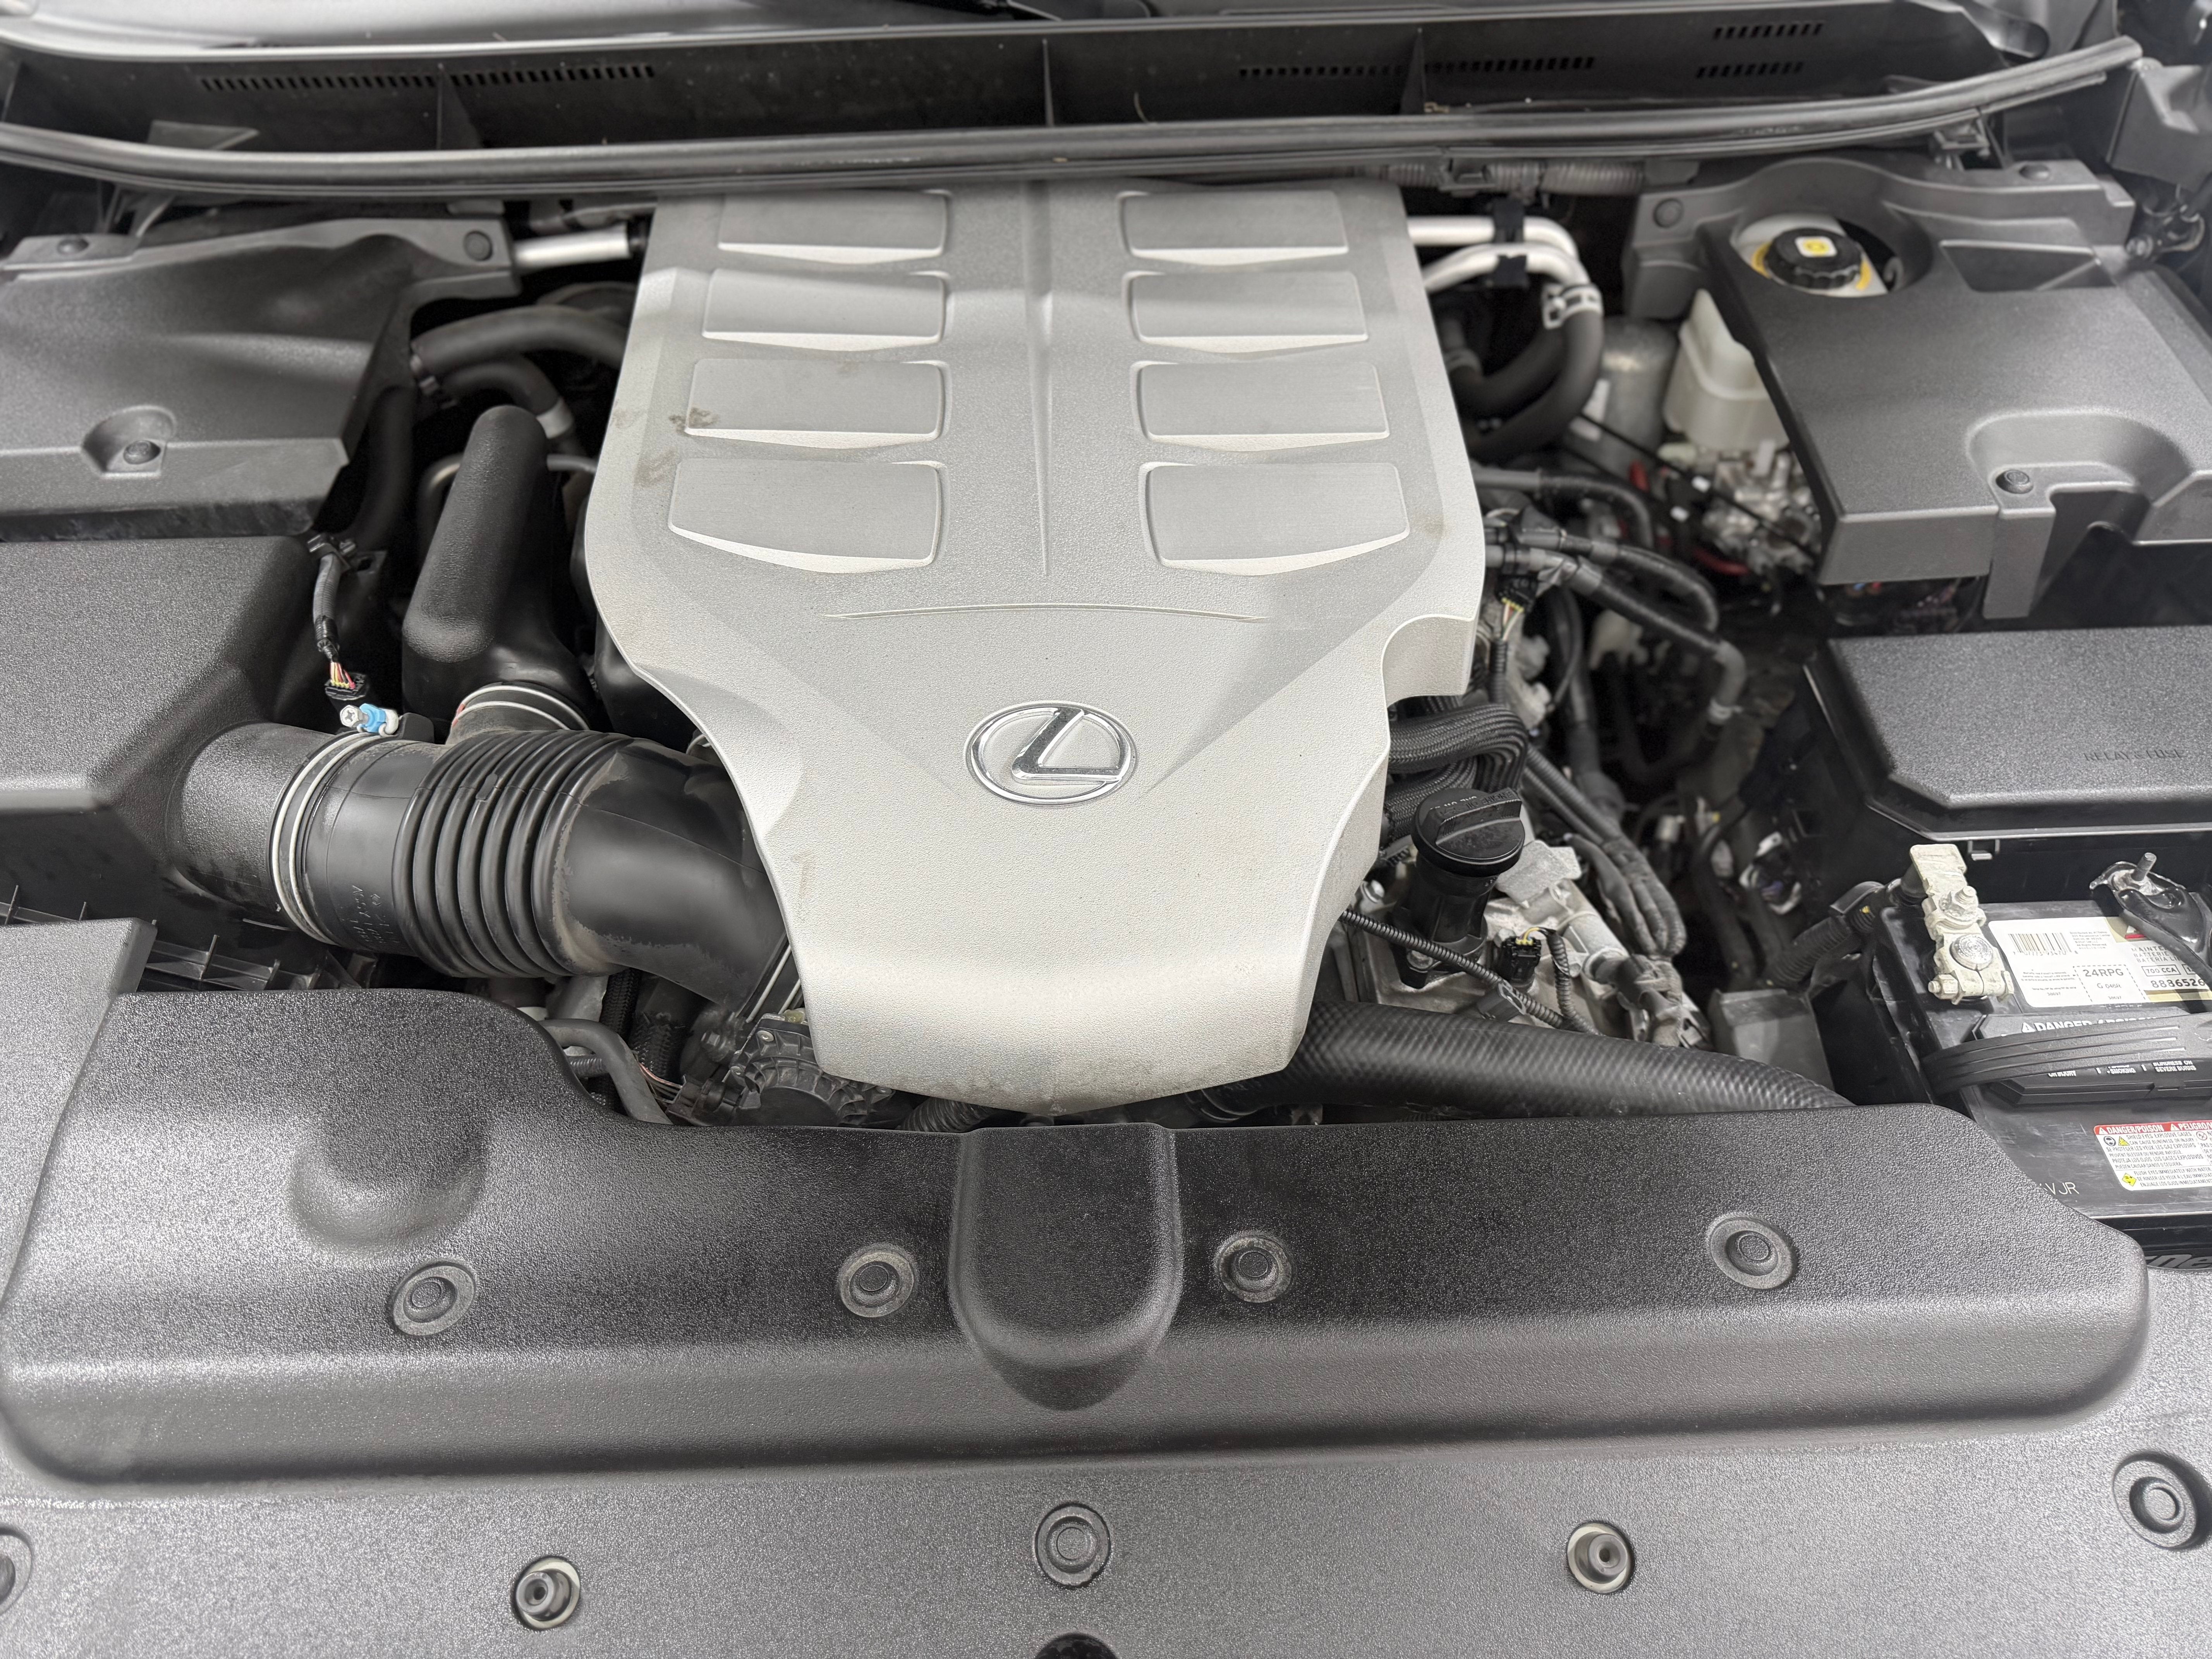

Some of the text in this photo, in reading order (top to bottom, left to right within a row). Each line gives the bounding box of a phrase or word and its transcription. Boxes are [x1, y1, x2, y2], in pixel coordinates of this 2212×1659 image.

[2084, 751, 2130, 761] RELAY
[2146, 749, 2187, 759] FUSE
[2082, 968, 2124, 977] 24RPG
[2106, 1124, 2165, 1134] DANGER/POISON
